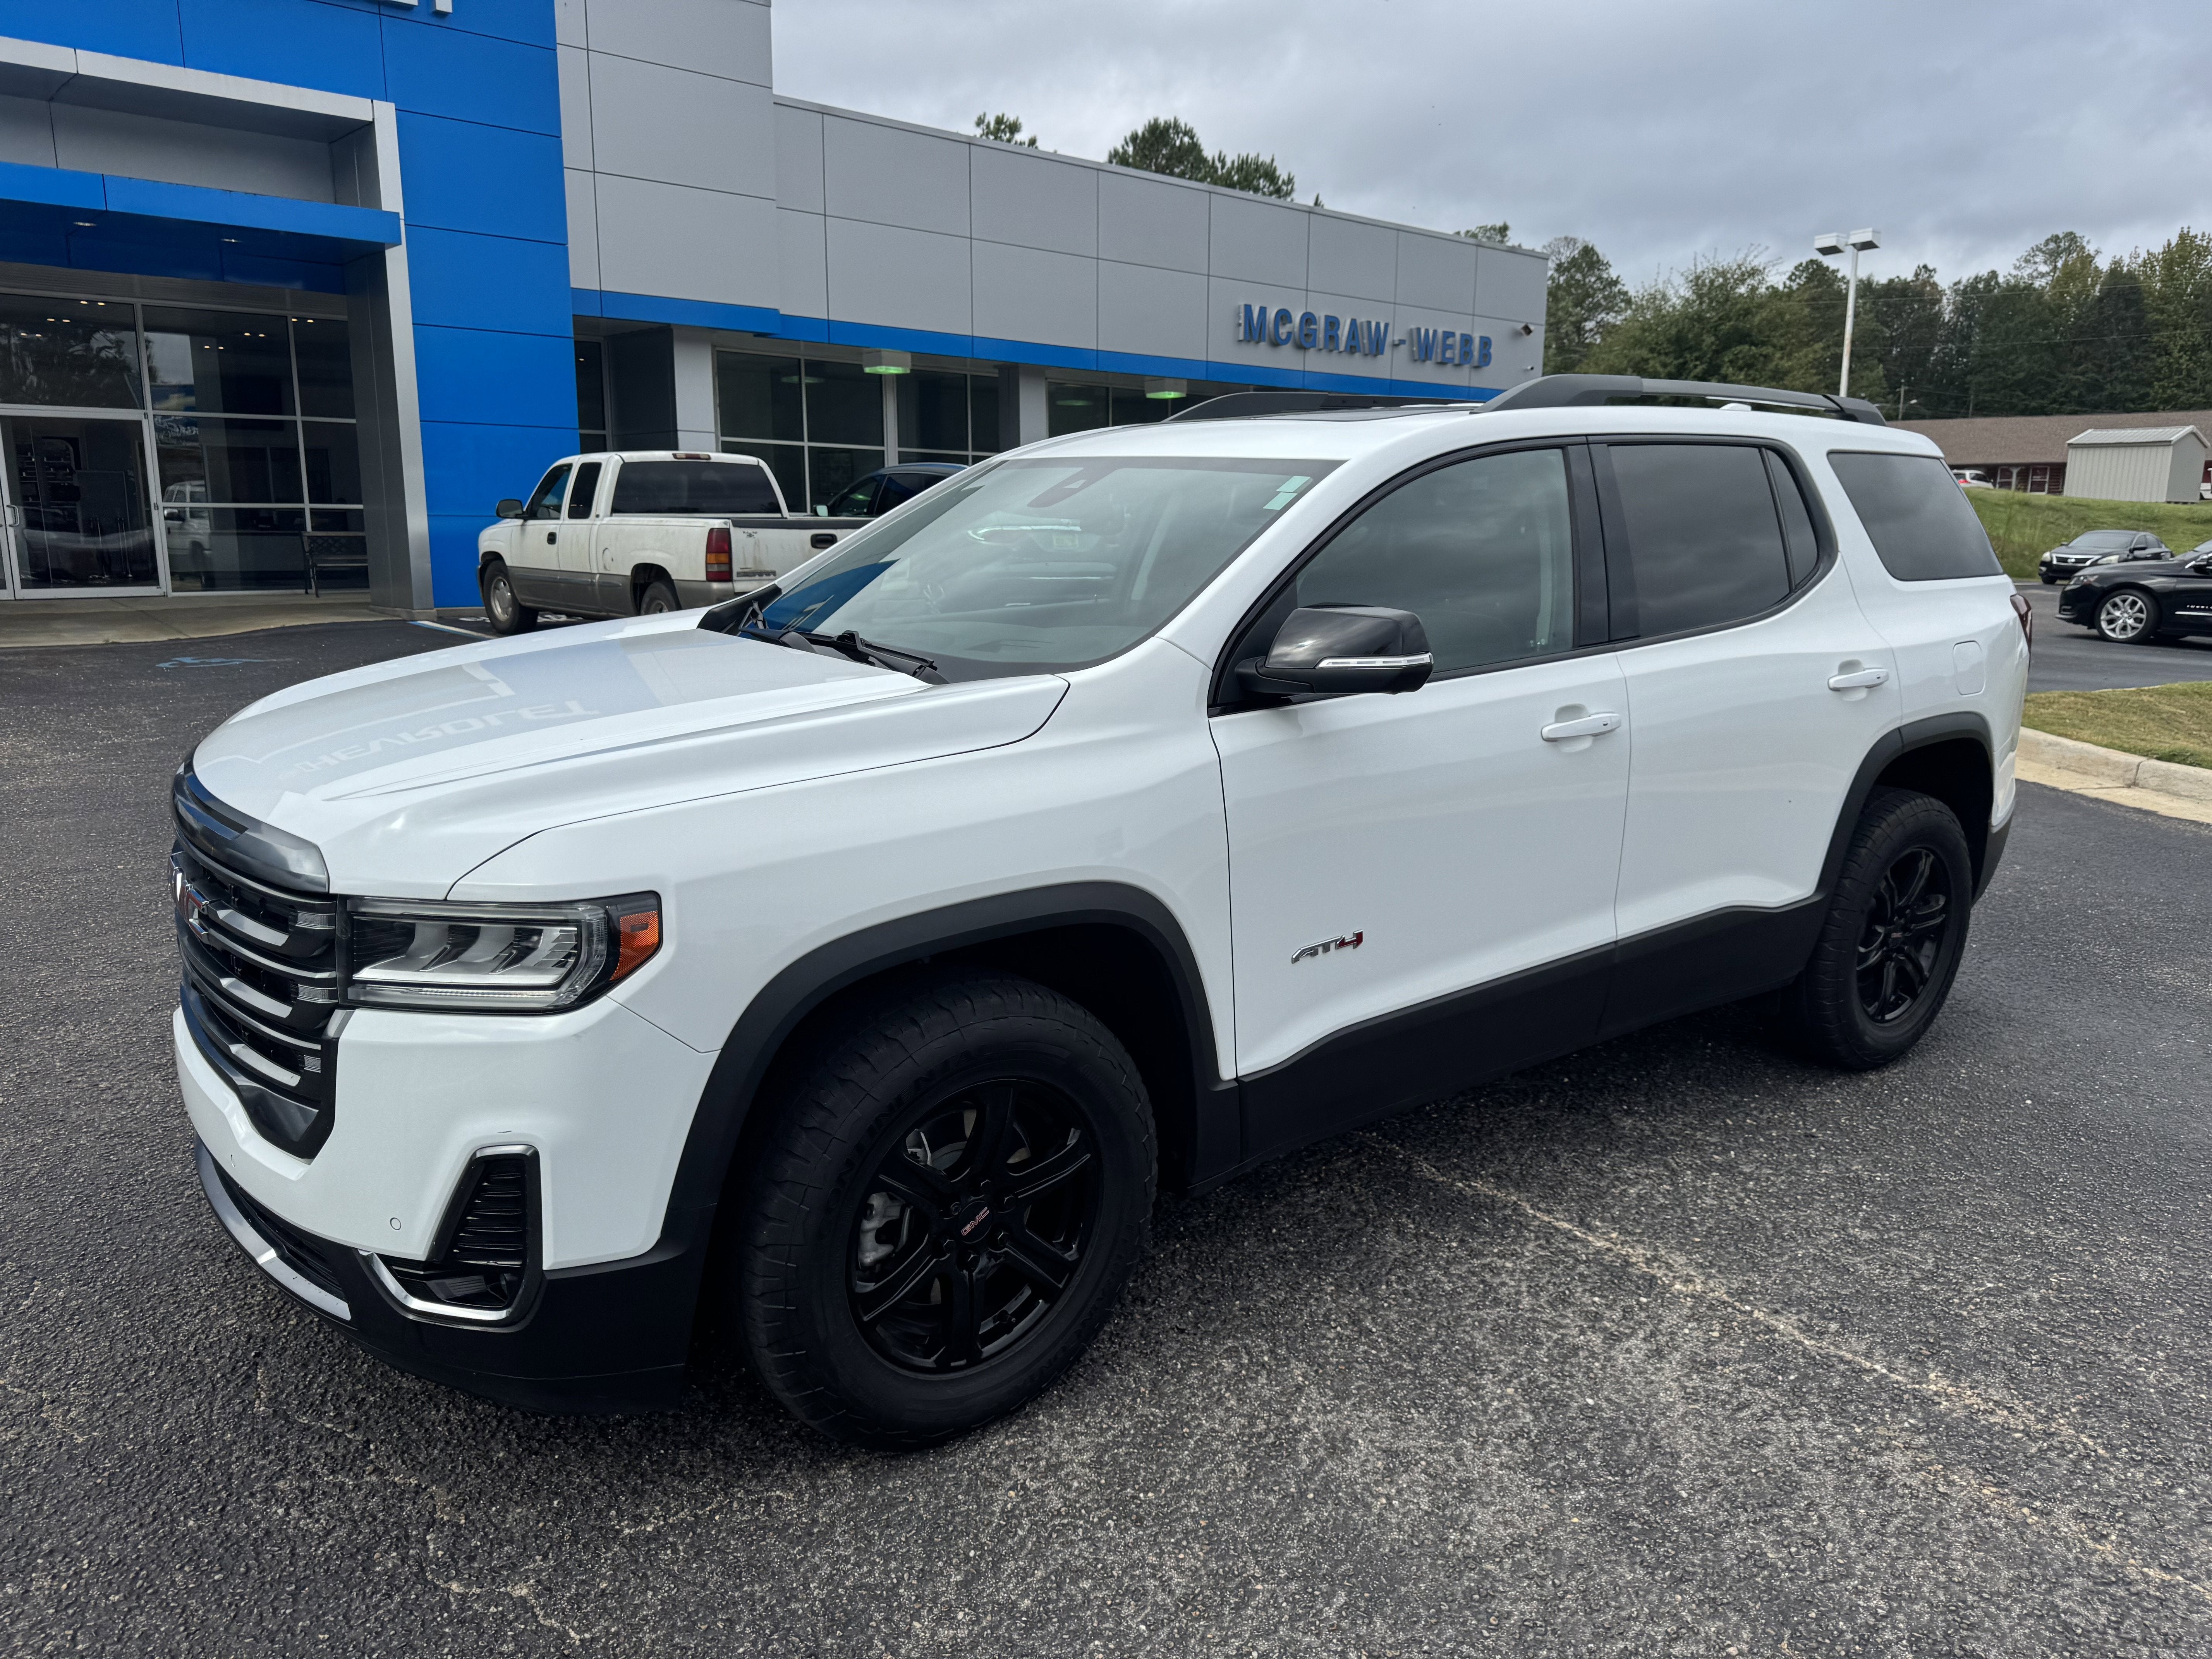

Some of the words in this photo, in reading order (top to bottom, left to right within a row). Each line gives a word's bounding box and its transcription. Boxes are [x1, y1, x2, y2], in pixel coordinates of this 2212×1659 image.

[1240, 304, 1492, 367] MCGRAW-WEBB
[1291, 929, 1363, 964] AT4
[961, 1206, 990, 1236] GMC
